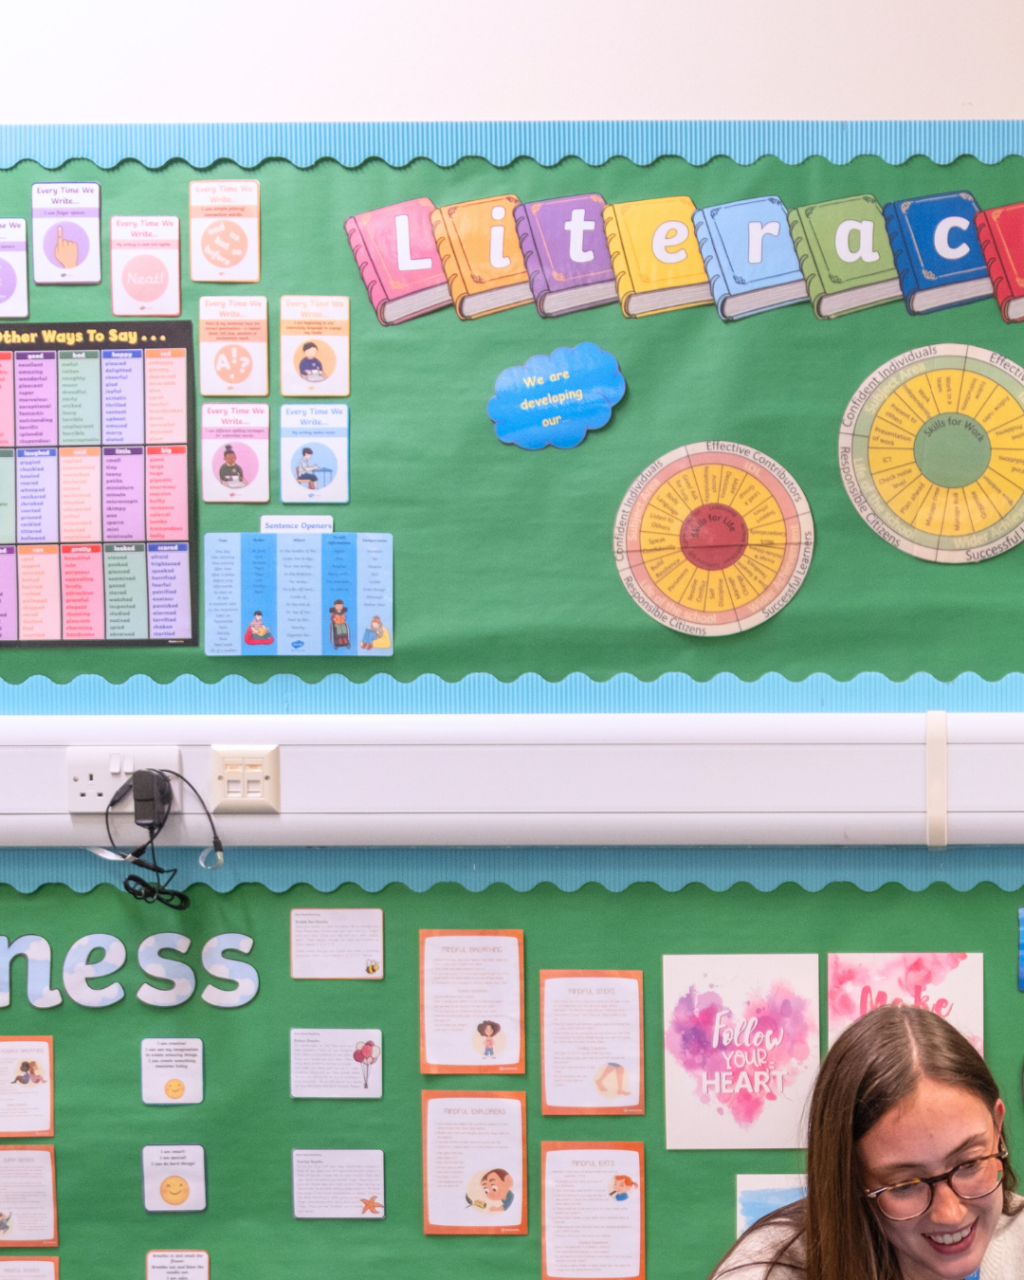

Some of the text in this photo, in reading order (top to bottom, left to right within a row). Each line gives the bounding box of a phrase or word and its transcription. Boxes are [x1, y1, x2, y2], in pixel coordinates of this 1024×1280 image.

[37, 186, 95, 195] Every Time We
[196, 185, 253, 194] Every Time We
[116, 219, 174, 228] Every Time We
[208, 223, 226, 235] and
[214, 236, 229, 250] but
[204, 245, 231, 266] before
[127, 267, 164, 285] Neat!
[42, 330, 83, 345] Ways
[87, 329, 105, 342] To
[108, 329, 138, 344] Say
[28, 352, 44, 360] good
[112, 351, 132, 359] happy
[523, 370, 570, 387] We are
[842, 346, 937, 427] Confident Individuals
[520, 389, 583, 410] developing
[865, 377, 898, 414] Subject
[286, 408, 307, 416] Every
[924, 417, 984, 442] Skills for Work
[706, 442, 802, 503] Effective Contributors
[840, 446, 901, 547] Responsible Citizens
[615, 460, 663, 562] Confident Individuals
[301, 522, 332, 530] Openers
[691, 514, 735, 538] Skills for Life
[71, 546, 91, 554] pretty
[965, 531, 1021, 561] Successful
[761, 531, 813, 618] Successful Learners
[624, 575, 706, 636] Responsible Citizens
[685, 612, 716, 622] school
[0, 932, 260, 1008] ness
[859, 985, 955, 1018] Mke
[712, 1008, 785, 1049] Follow
[722, 1049, 768, 1070] YOUR
[701, 1070, 789, 1094] HEART
